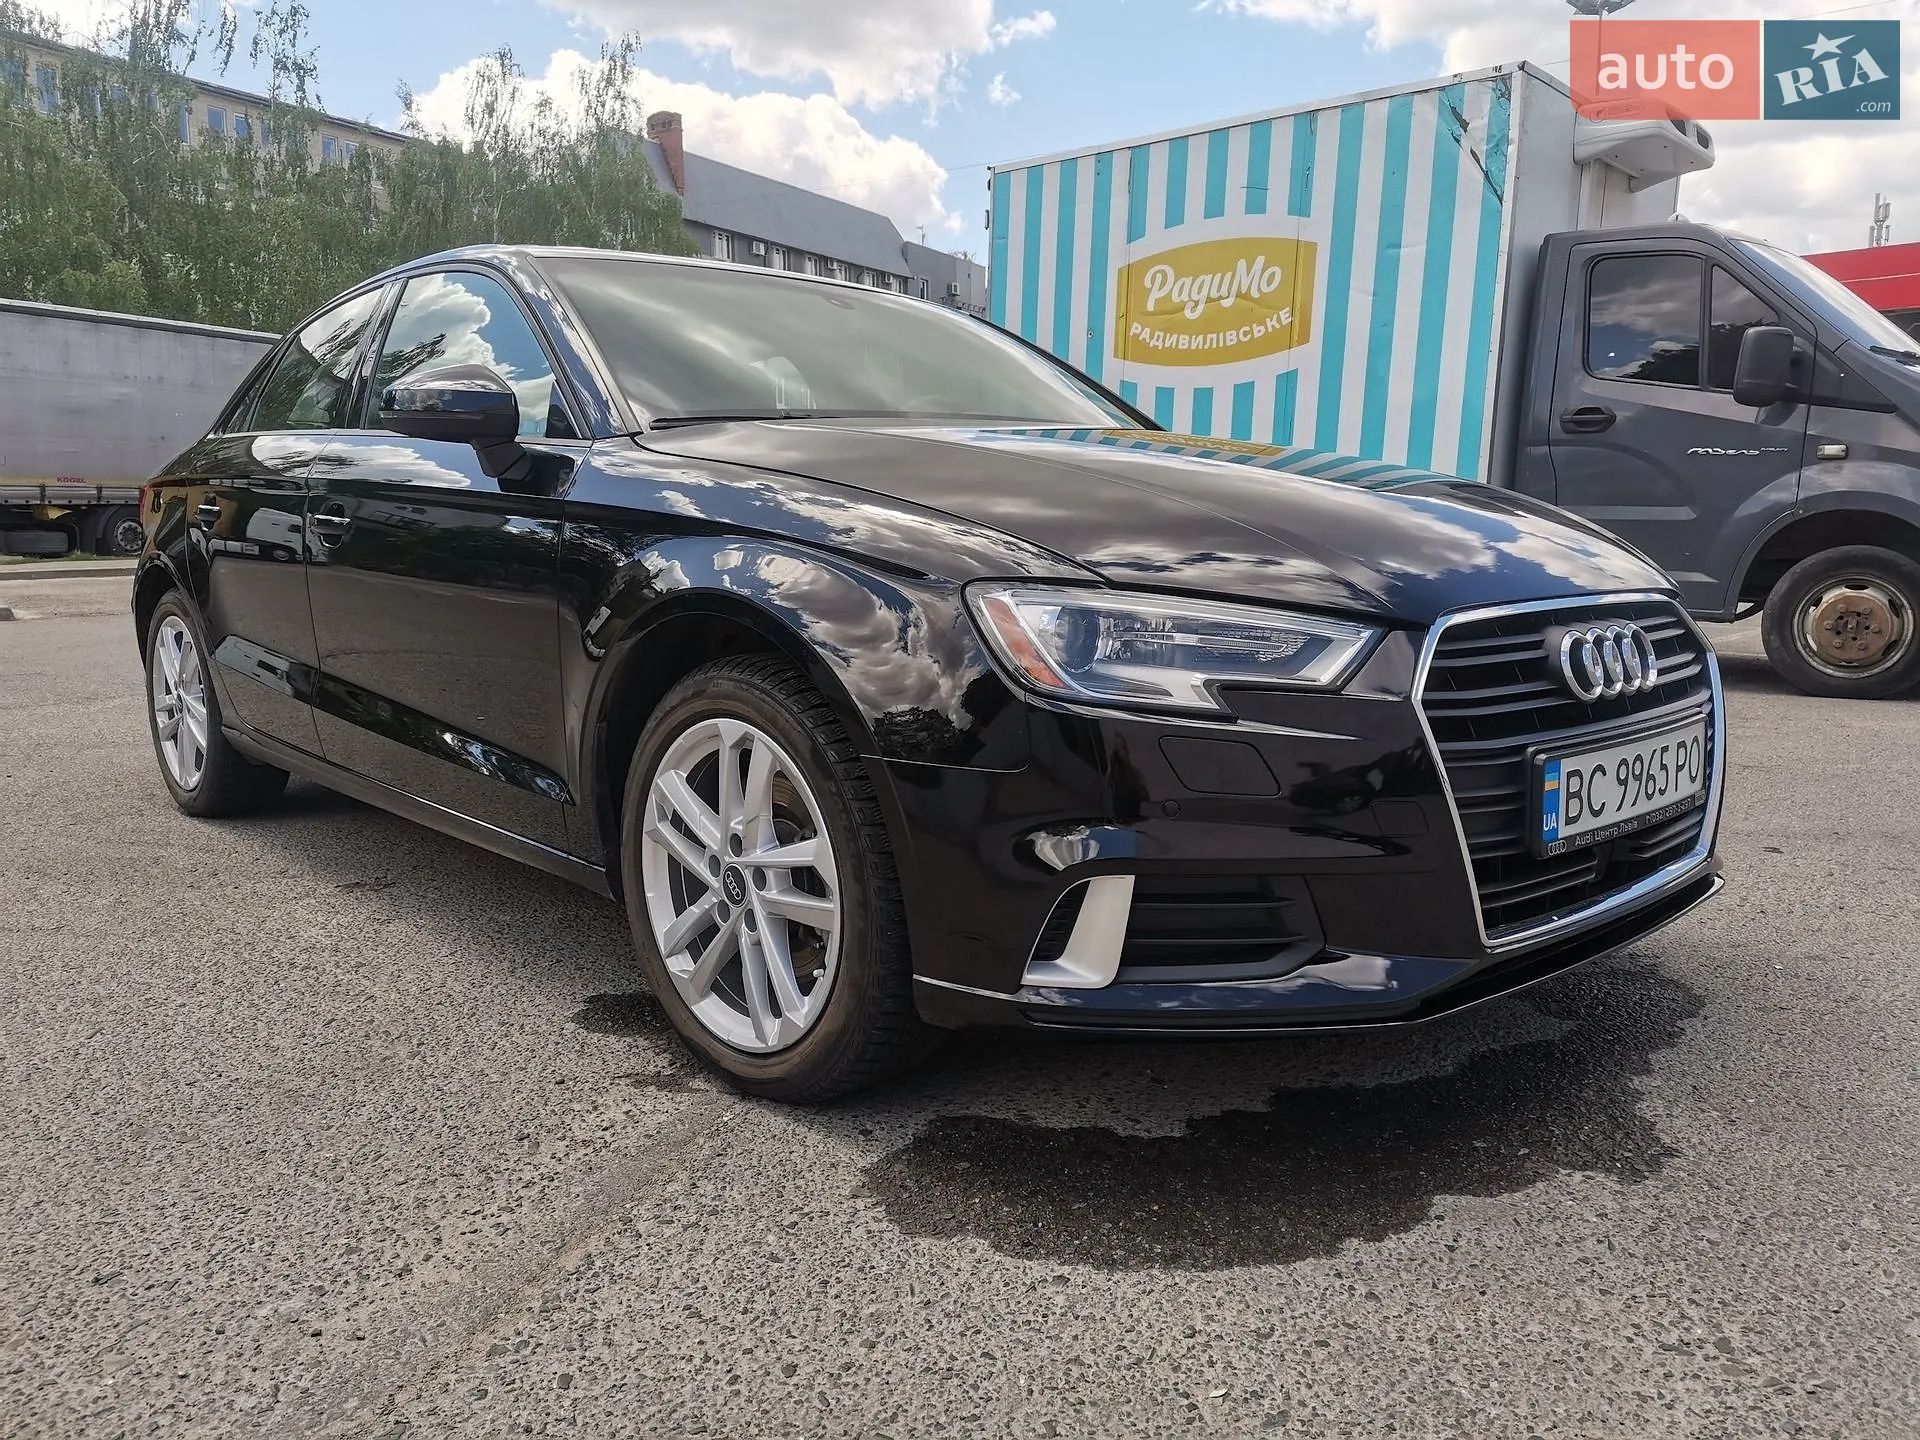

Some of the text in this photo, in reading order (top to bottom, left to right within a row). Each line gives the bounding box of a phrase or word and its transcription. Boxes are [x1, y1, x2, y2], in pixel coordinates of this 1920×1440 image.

[1130, 307, 1293, 350] РАДИВИЛІВСЬКЕ
[1564, 734, 1701, 826] BC 9965 PO
[1543, 812, 1557, 831] UA
[1575, 831, 1593, 847] Audi
[1595, 825, 1619, 841] Центр
